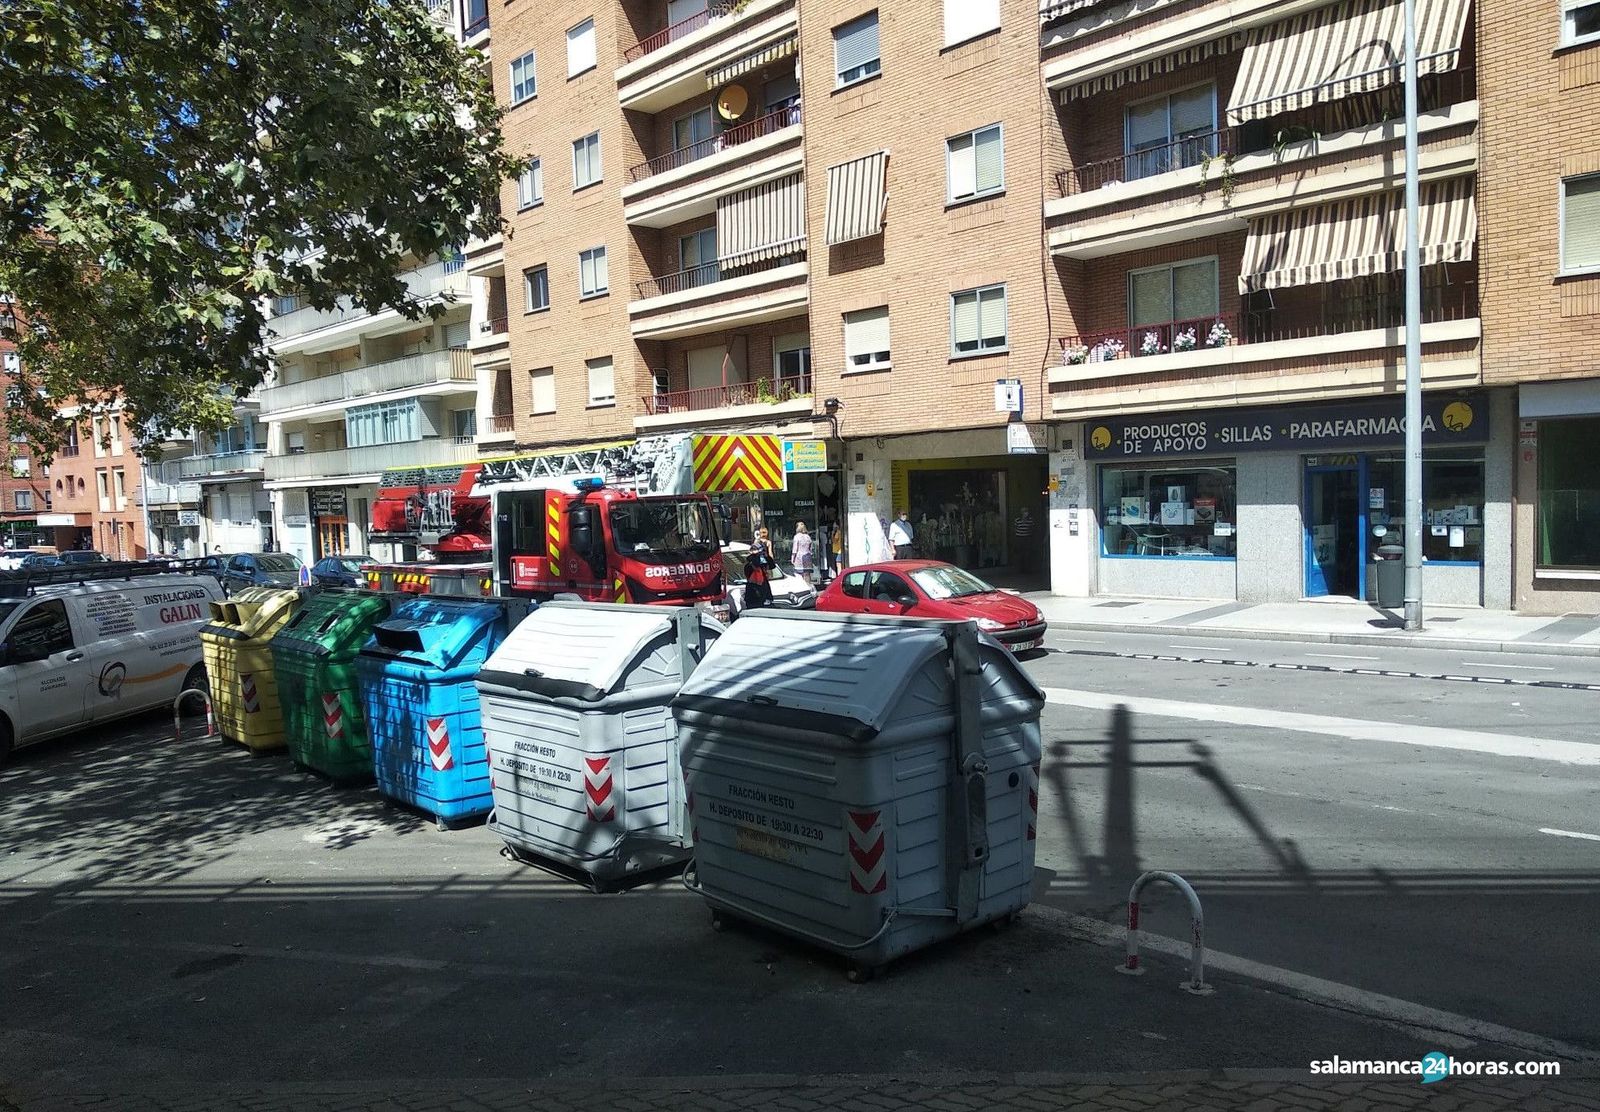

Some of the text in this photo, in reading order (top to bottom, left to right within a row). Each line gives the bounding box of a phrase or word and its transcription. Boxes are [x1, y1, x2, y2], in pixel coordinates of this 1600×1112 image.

[1123, 421, 1207, 440] PRODUCTOS
[1221, 425, 1272, 443] SILLAS
[1290, 414, 1437, 440] PARAFARMACA
[1124, 436, 1207, 454] DE APOYO
[144, 589, 206, 605] INSTALACIONES
[160, 604, 202, 624] GALIN
[540, 747, 556, 758] RESTO
[530, 764, 537, 774] DE
[539, 766, 552, 778] 19:30
[557, 770, 572, 782] 22:30
[728, 784, 795, 810] FRACCIÓN RESTO
[709, 802, 718, 813] H.
[756, 814, 767, 826] DE
[771, 819, 792, 833] 19:30
[794, 824, 800, 835] A
[801, 826, 824, 841] 22:30
